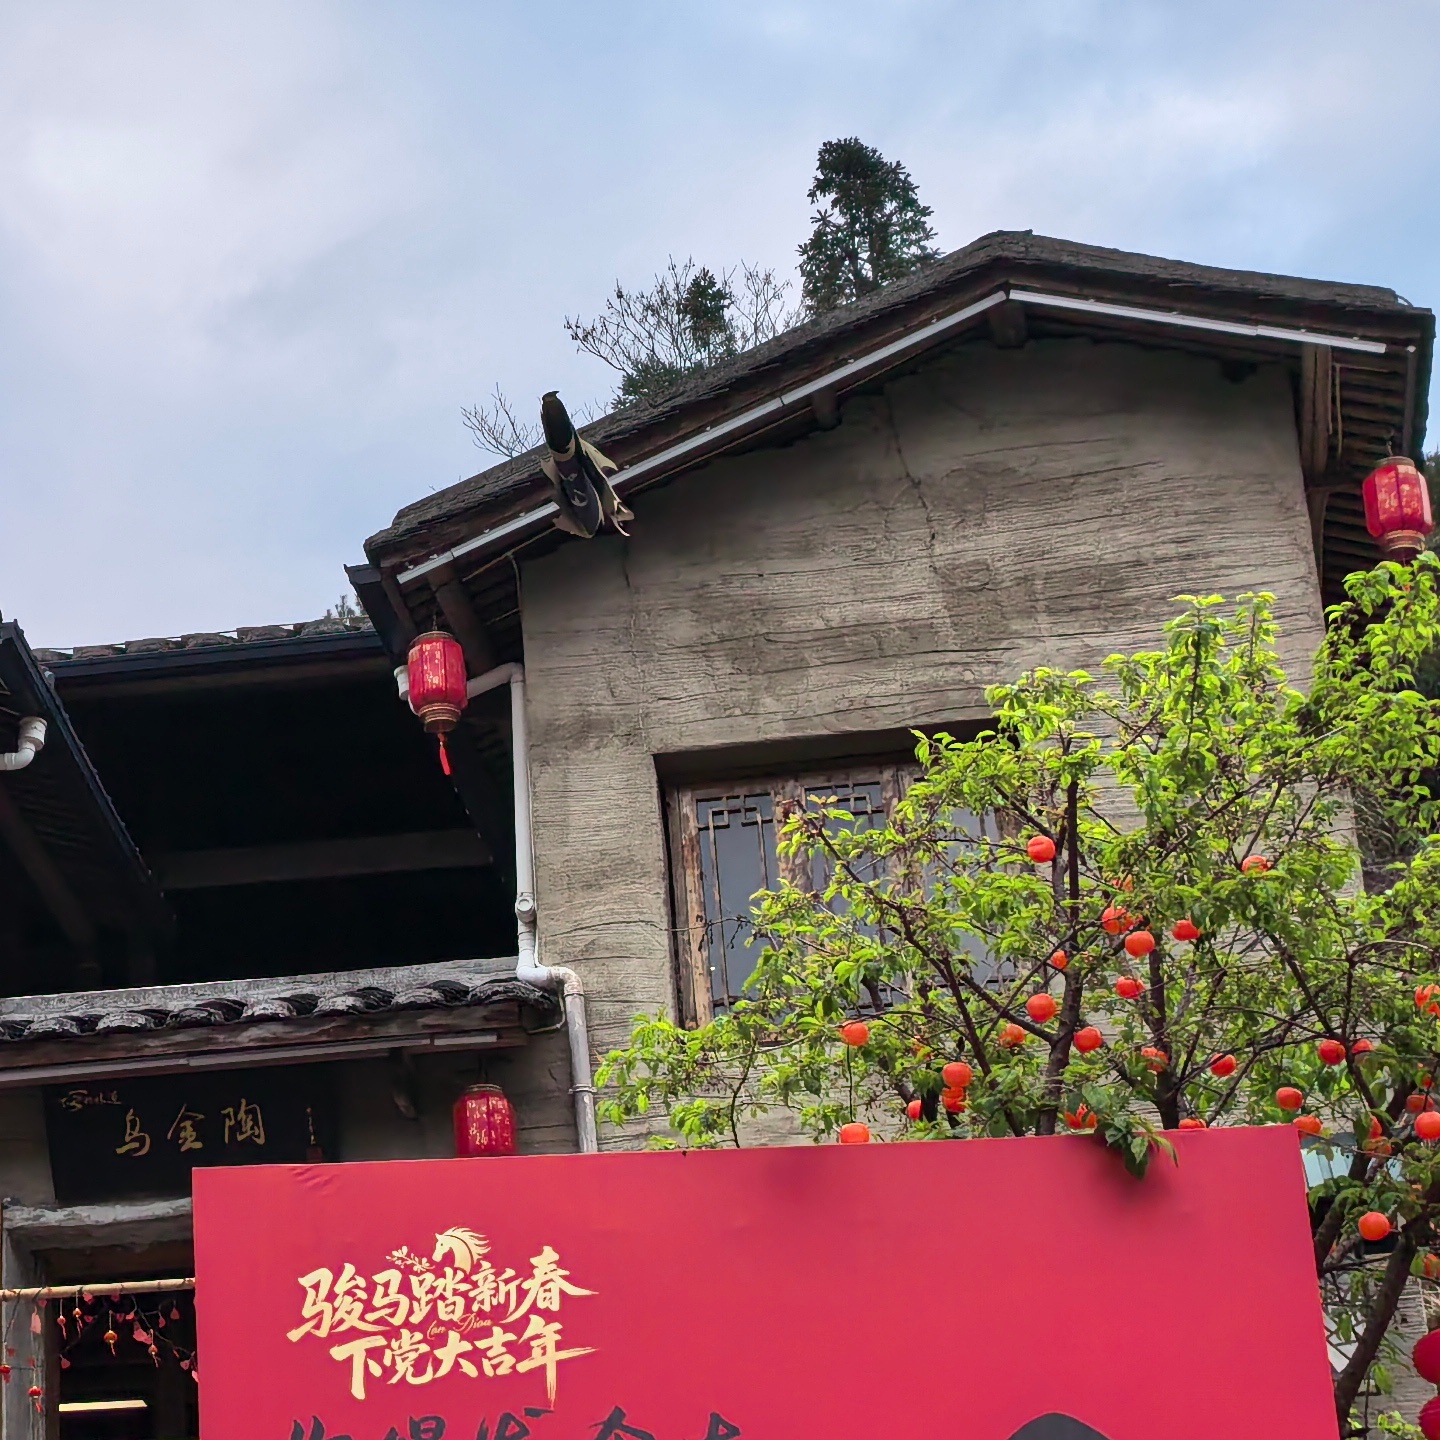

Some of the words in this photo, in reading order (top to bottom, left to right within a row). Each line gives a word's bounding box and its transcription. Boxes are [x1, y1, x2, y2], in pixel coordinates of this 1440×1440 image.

[114, 1097, 267, 1158] 乌金陶
[286, 1246, 600, 1344] 骏马踏新春
[328, 1314, 600, 1411] 下党大吉年
